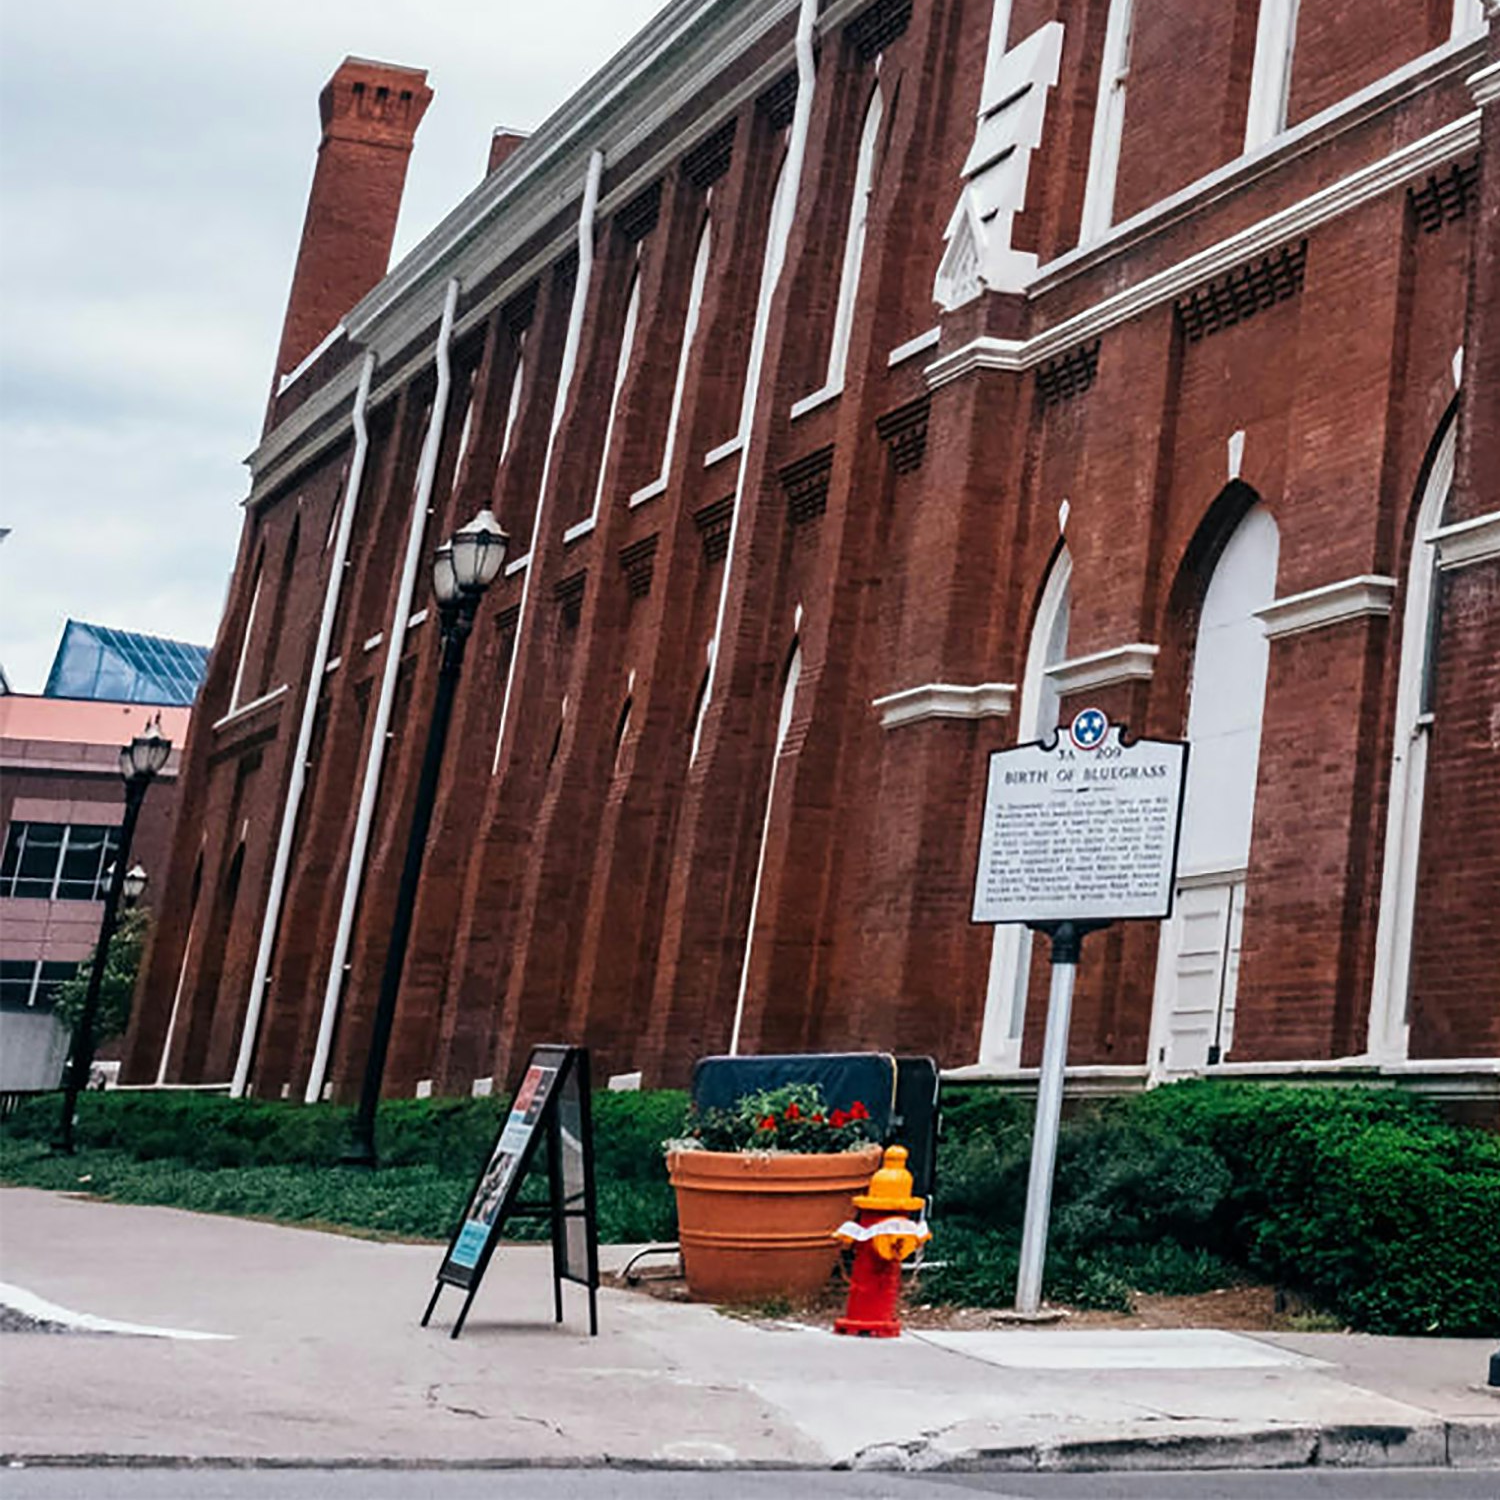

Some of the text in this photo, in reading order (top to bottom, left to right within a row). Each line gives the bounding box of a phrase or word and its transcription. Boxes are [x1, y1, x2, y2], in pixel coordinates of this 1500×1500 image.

[1095, 746, 1122, 761] 209
[1004, 765, 1168, 785] BIRTH OF BLUEGRASS
